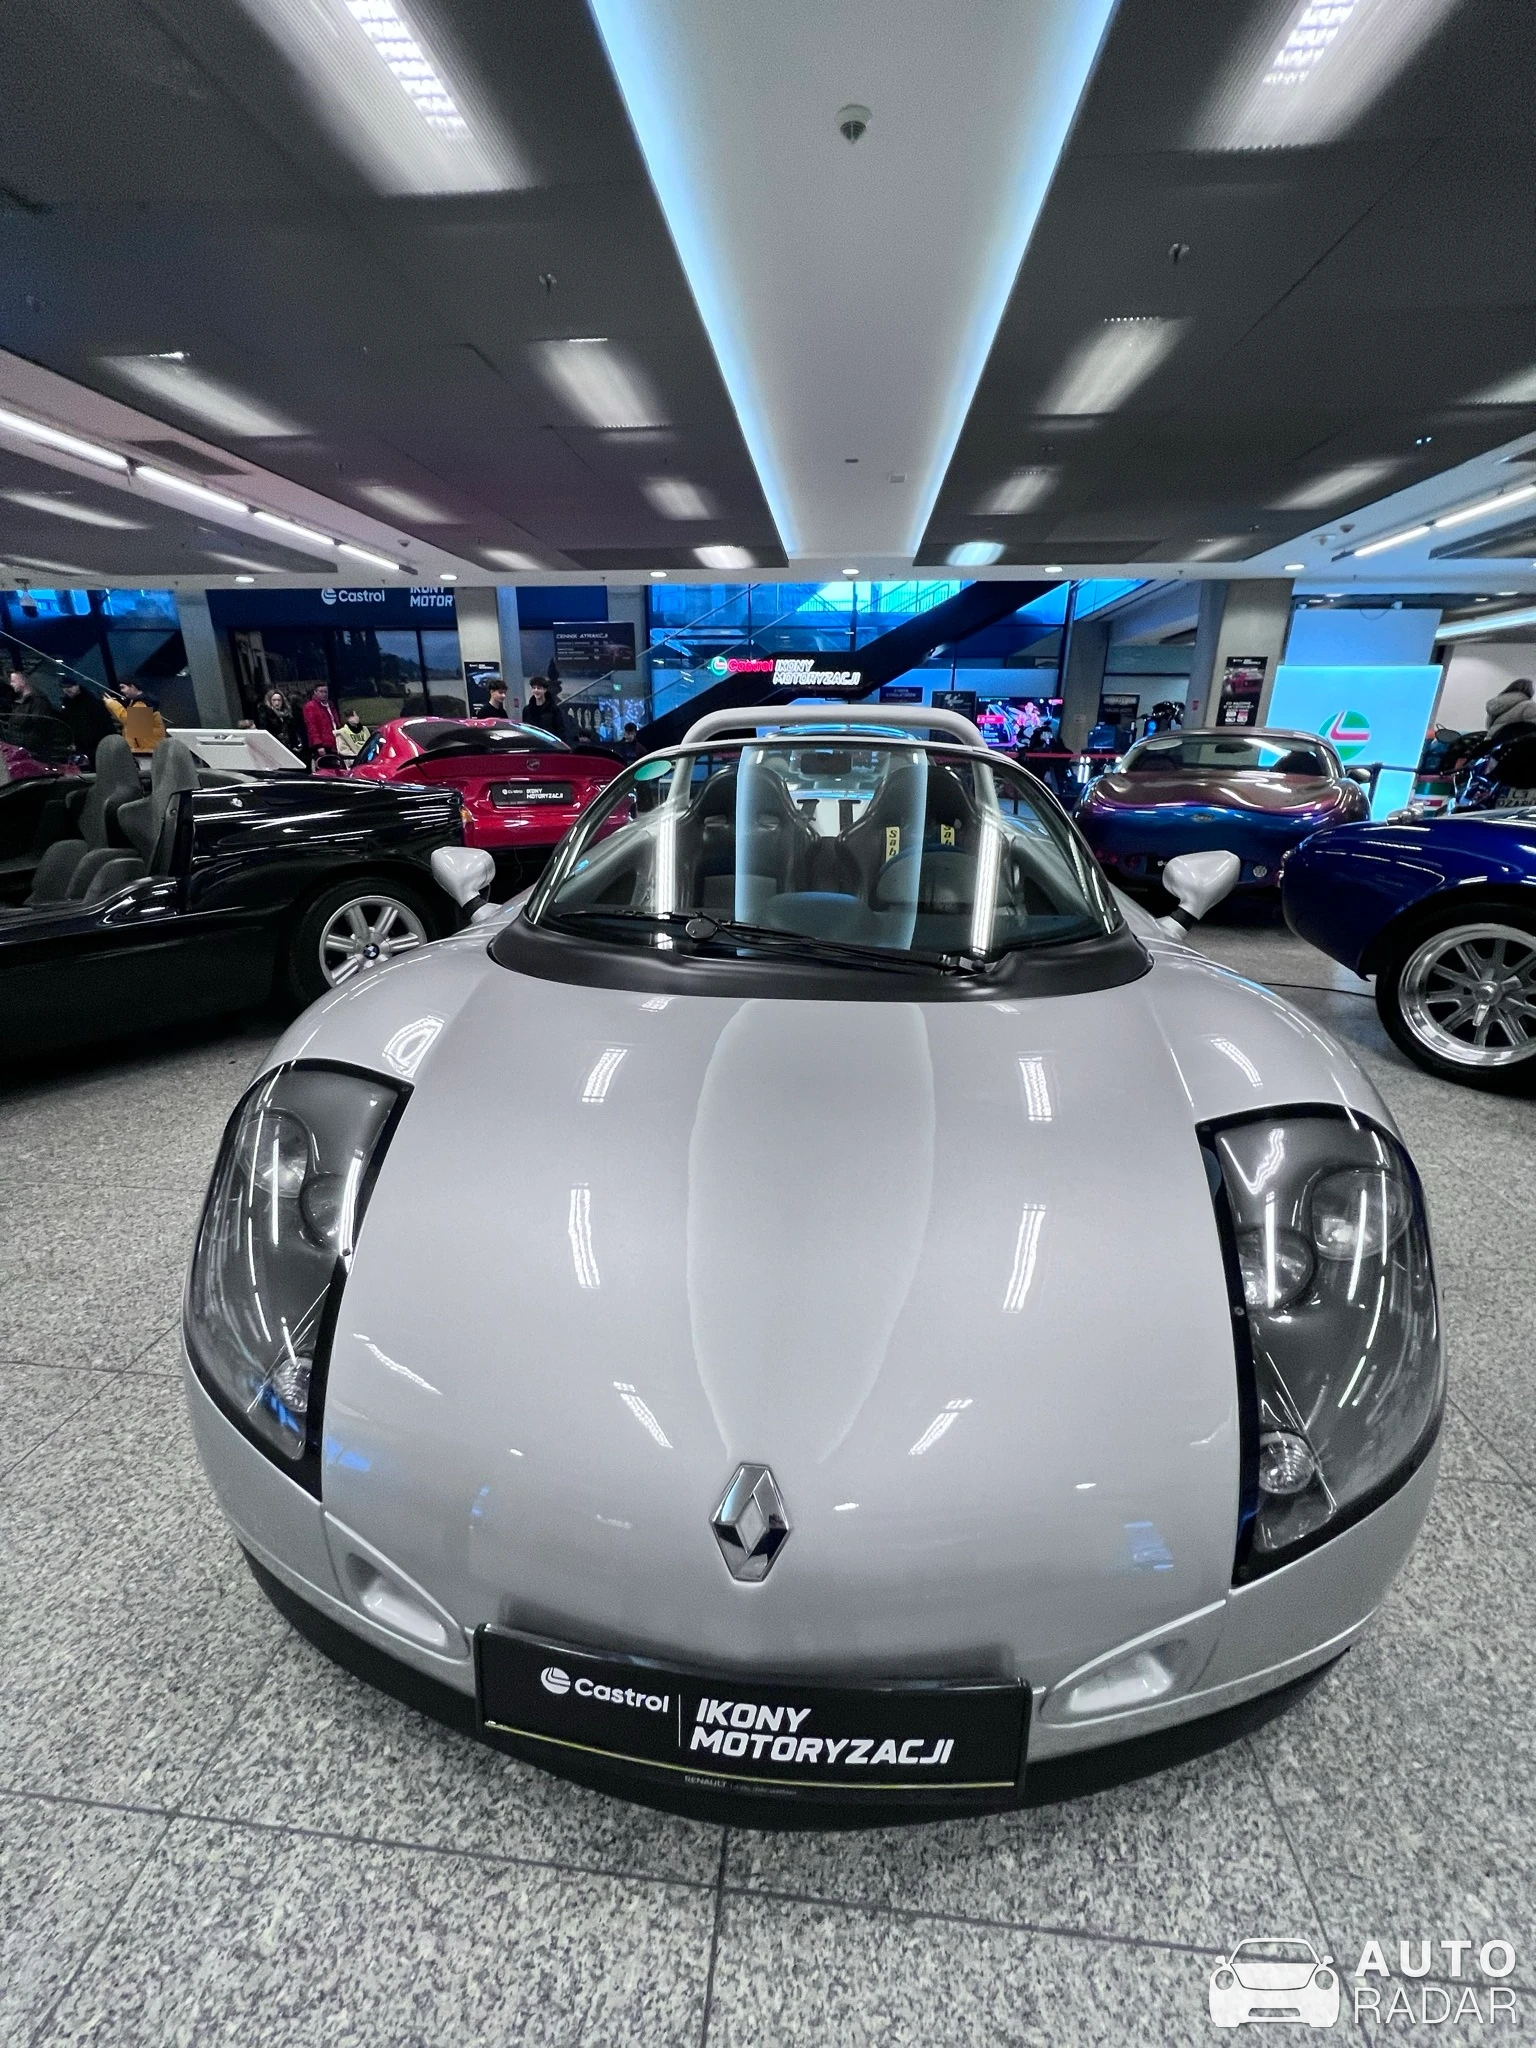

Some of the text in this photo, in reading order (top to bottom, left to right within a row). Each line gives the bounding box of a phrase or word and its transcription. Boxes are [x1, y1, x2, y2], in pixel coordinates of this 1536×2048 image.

[338, 589, 386, 602] Castrol
[410, 595, 455, 607] MOTOR
[727, 658, 774, 672] Castrol
[774, 659, 815, 672] IKONY
[772, 671, 861, 686] MOTORYZACJI
[574, 1678, 670, 1713] Castrol
[696, 1698, 812, 1733] IKONY
[689, 1726, 955, 1765] MOTORYZACJI
[684, 1775, 727, 1788] RENAULT
